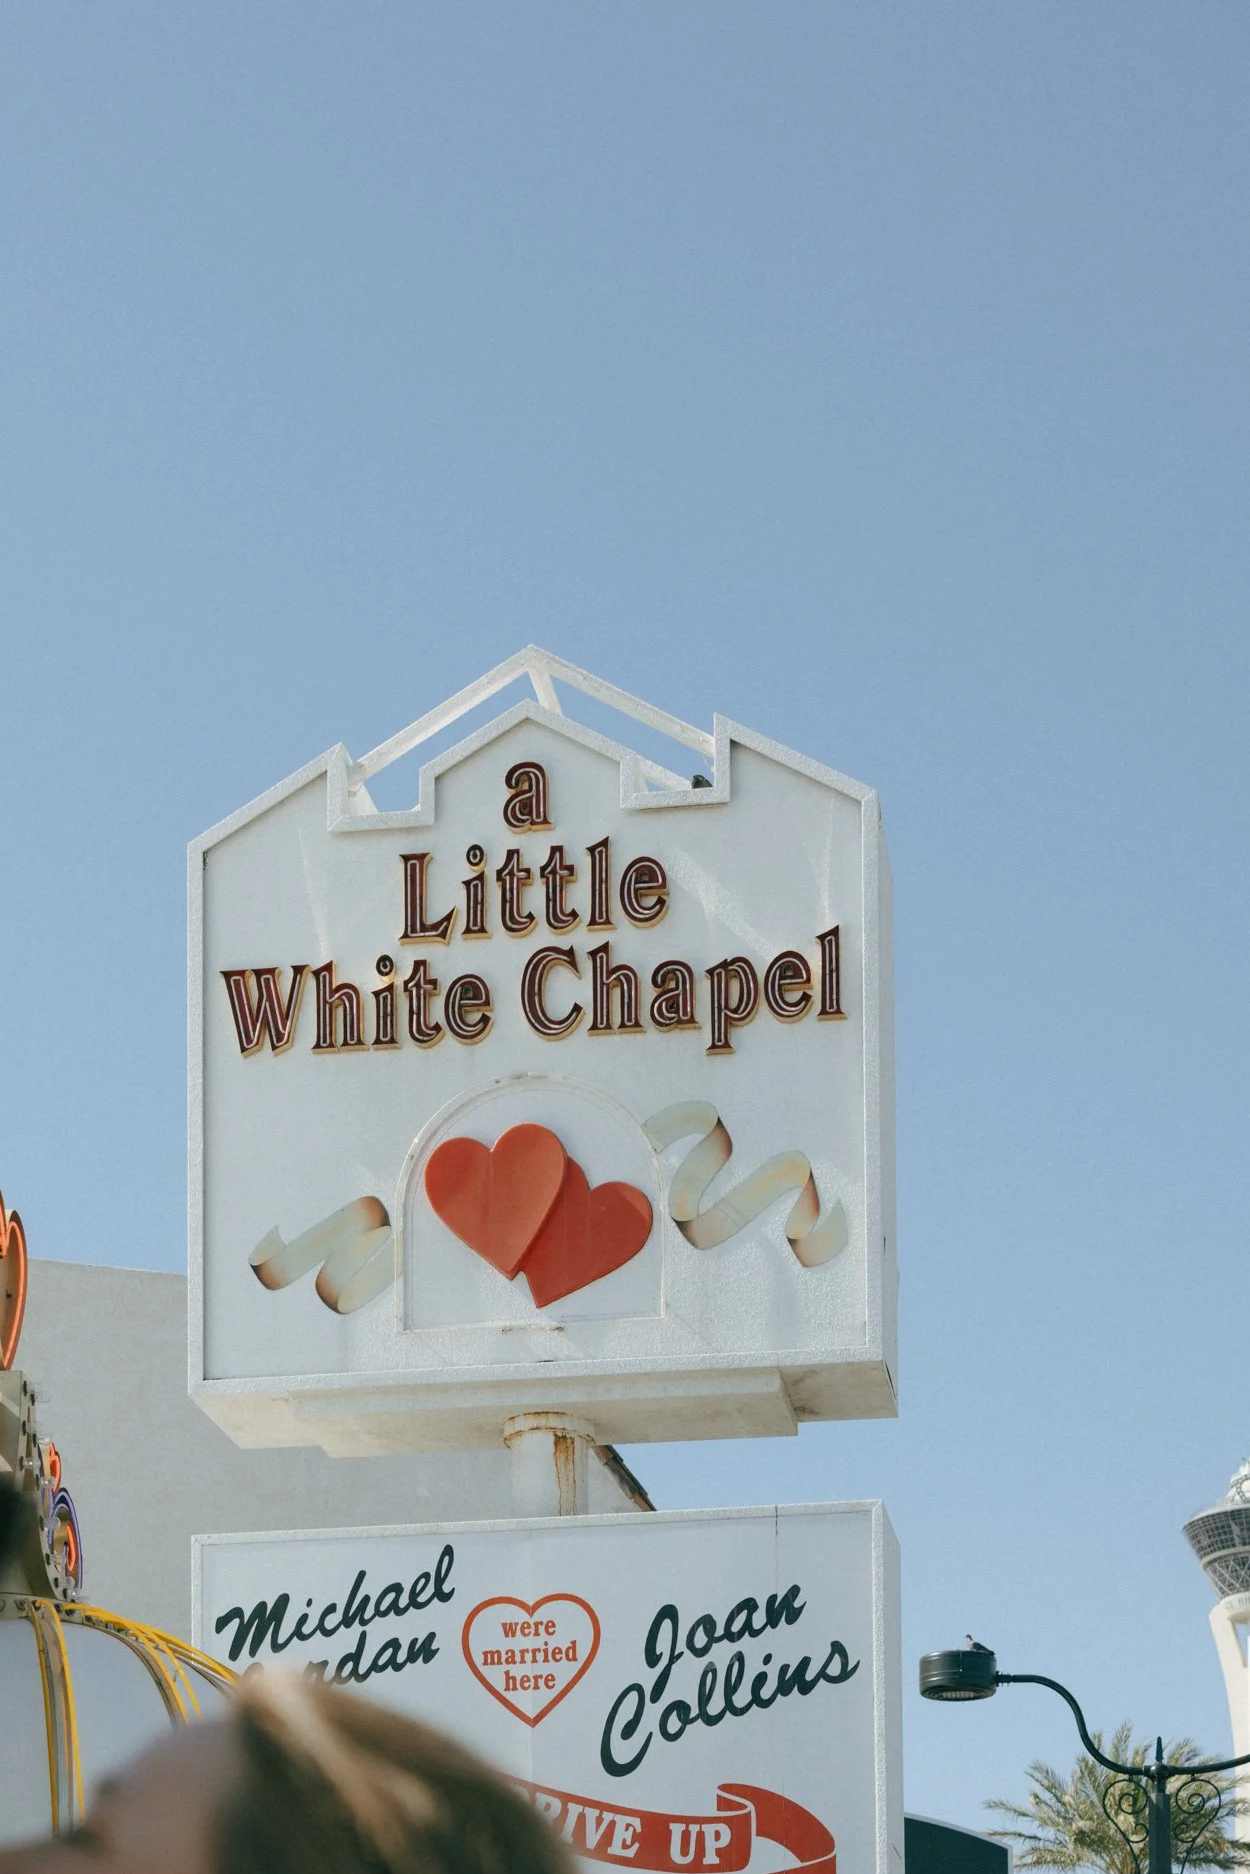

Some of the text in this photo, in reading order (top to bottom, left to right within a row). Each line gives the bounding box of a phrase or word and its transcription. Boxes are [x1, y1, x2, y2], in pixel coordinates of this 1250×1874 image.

[503, 761, 554, 834] a
[398, 836, 669, 945] Little
[220, 925, 848, 1058] White Chapel
[215, 1544, 456, 1662] Michael
[501, 1619, 557, 1638] were
[242, 1630, 440, 1690] rdan
[482, 1640, 578, 1666] married
[503, 1668, 557, 1692] here
[644, 1584, 807, 1704] Joan
[600, 1640, 860, 1778] Collins
[512, 1784, 732, 1865] RIVE UP
